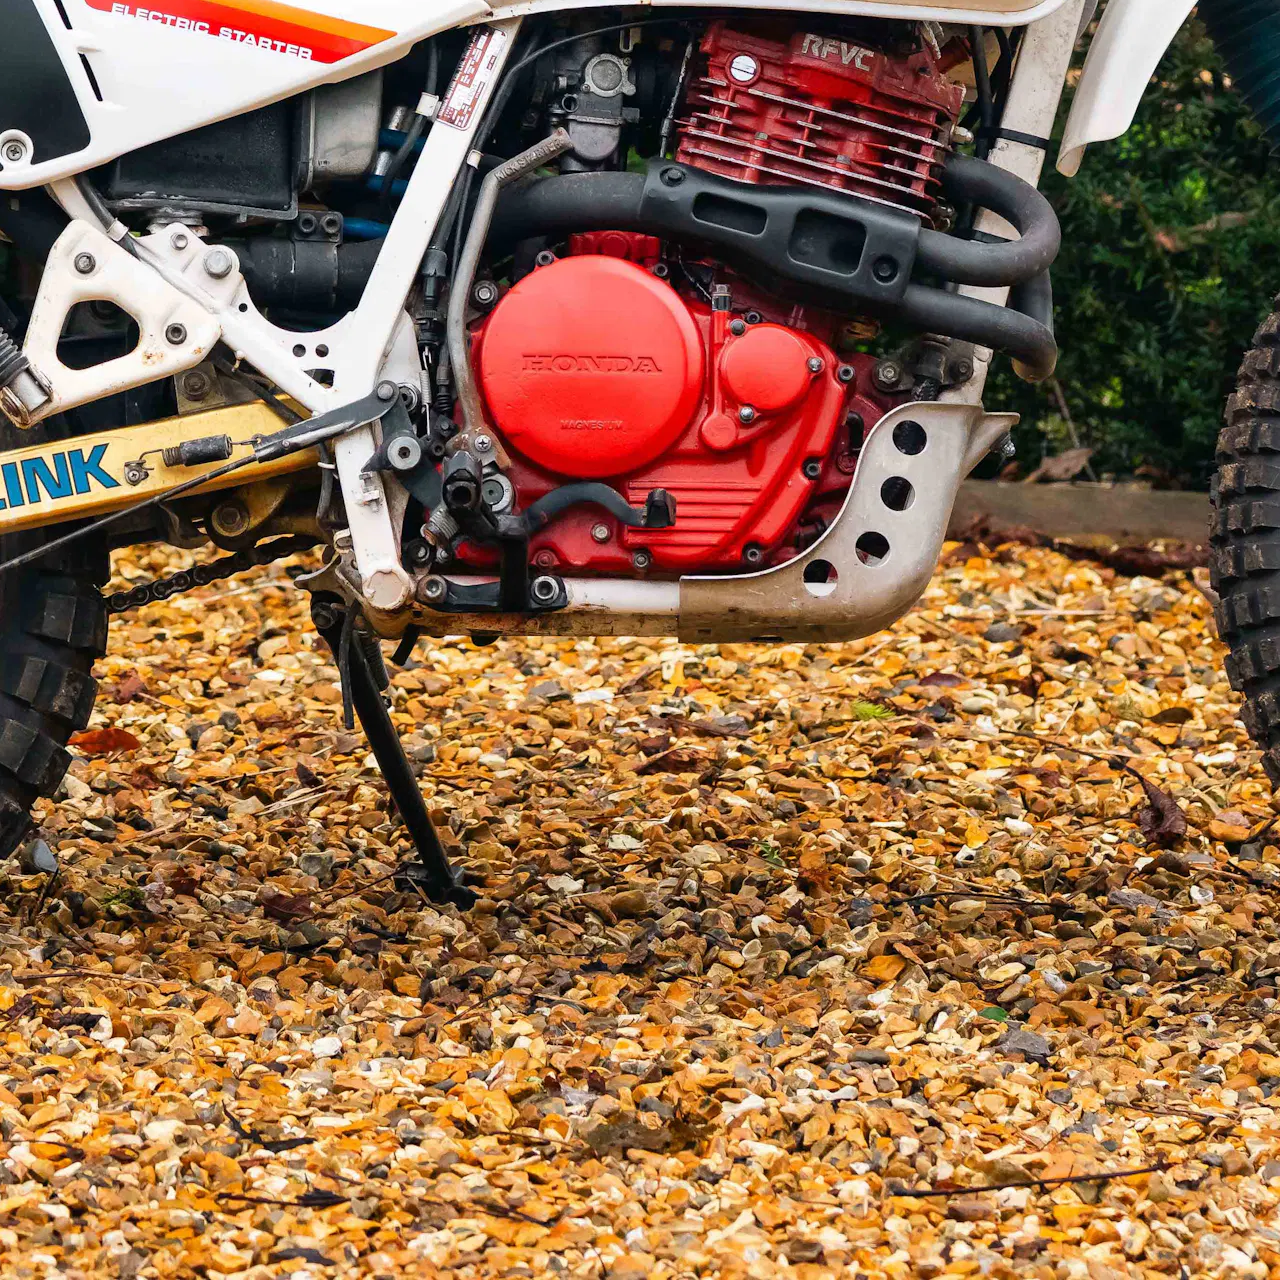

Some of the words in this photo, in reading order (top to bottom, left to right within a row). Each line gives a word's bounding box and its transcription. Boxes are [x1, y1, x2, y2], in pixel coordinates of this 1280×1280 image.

[111, 3, 209, 33] ELECTRIC
[219, 26, 312, 60] STARTER
[801, 33, 874, 72] RFVC
[522, 354, 663, 373] HONDA
[560, 420, 624, 431] MAGNESIUM
